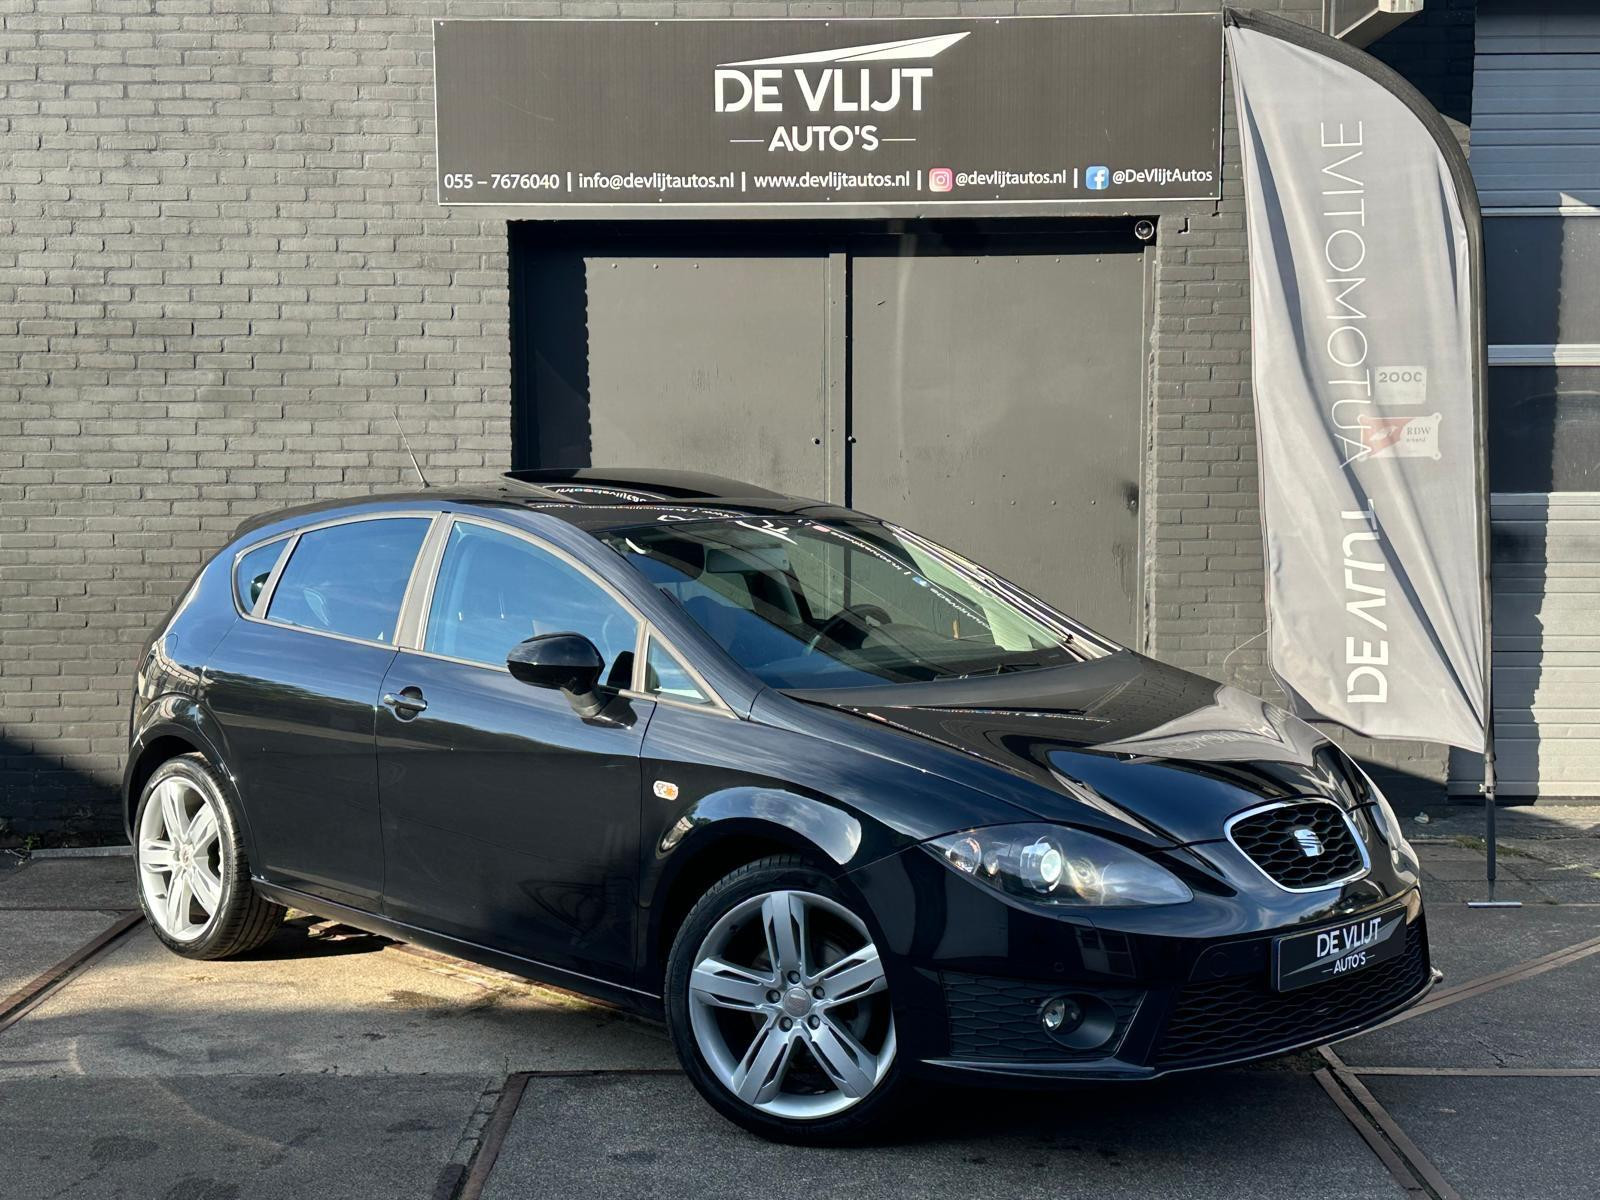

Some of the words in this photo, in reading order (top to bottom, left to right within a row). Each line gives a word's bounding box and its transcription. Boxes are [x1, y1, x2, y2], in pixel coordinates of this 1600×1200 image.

[714, 69, 783, 113] DE
[794, 67, 934, 112] VLIJT
[768, 125, 879, 152] AUTO'S
[444, 174, 474, 190] 055
[491, 173, 560, 190] 7676040
[578, 171, 735, 192] info@devlijtautos.nl
[753, 170, 910, 191] www.devlijtautos.nl
[955, 169, 1067, 189] @devlijtautos.nl
[1112, 168, 1213, 186] @DeVlijtAutos
[1316, 930, 1340, 958] DE
[1342, 917, 1382, 950] VLIJT
[1333, 951, 1367, 974] AUTO'S
